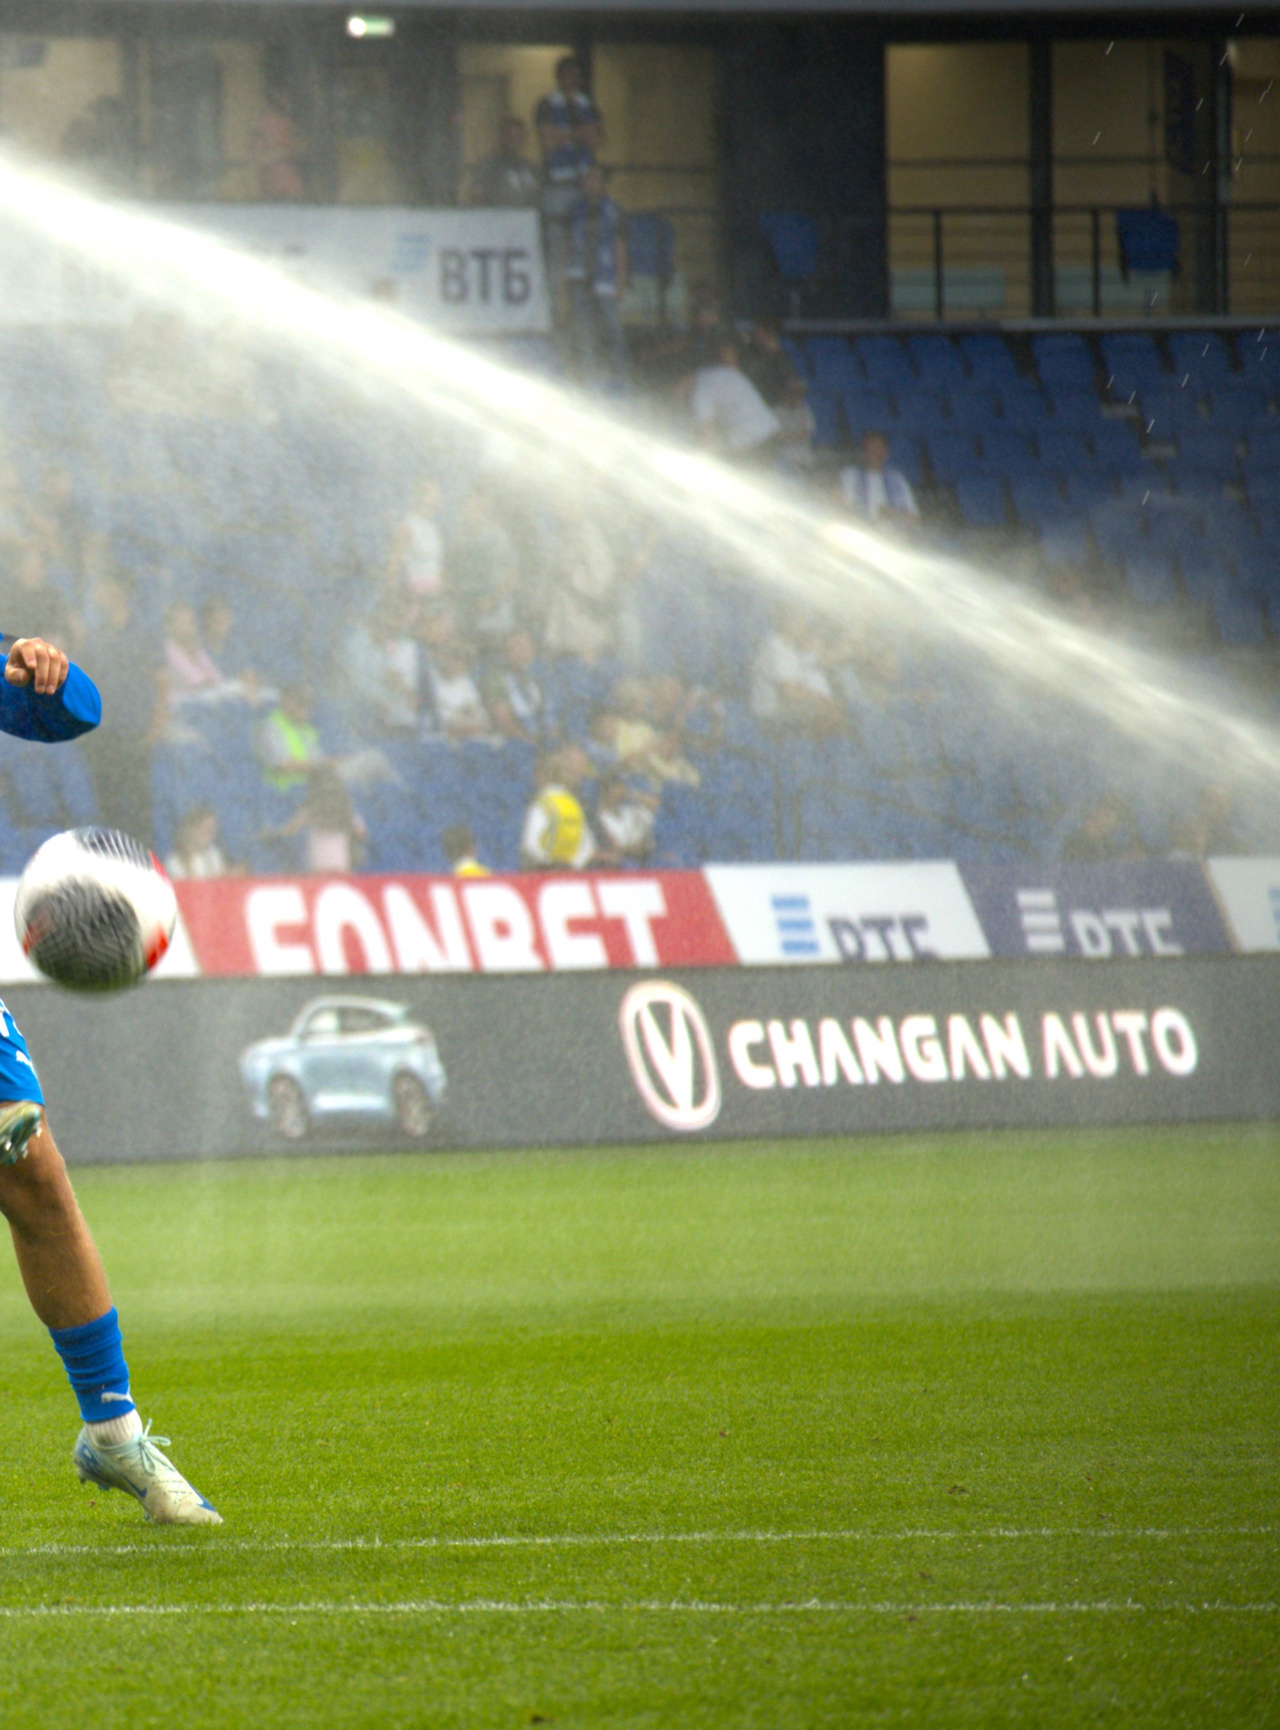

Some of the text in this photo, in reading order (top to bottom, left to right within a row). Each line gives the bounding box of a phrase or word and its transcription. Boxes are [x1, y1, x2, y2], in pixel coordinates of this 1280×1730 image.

[437, 246, 532, 308] ВТБ
[728, 1012, 1031, 1090] CHANGAN
[1041, 1006, 1199, 1077] AUTO
